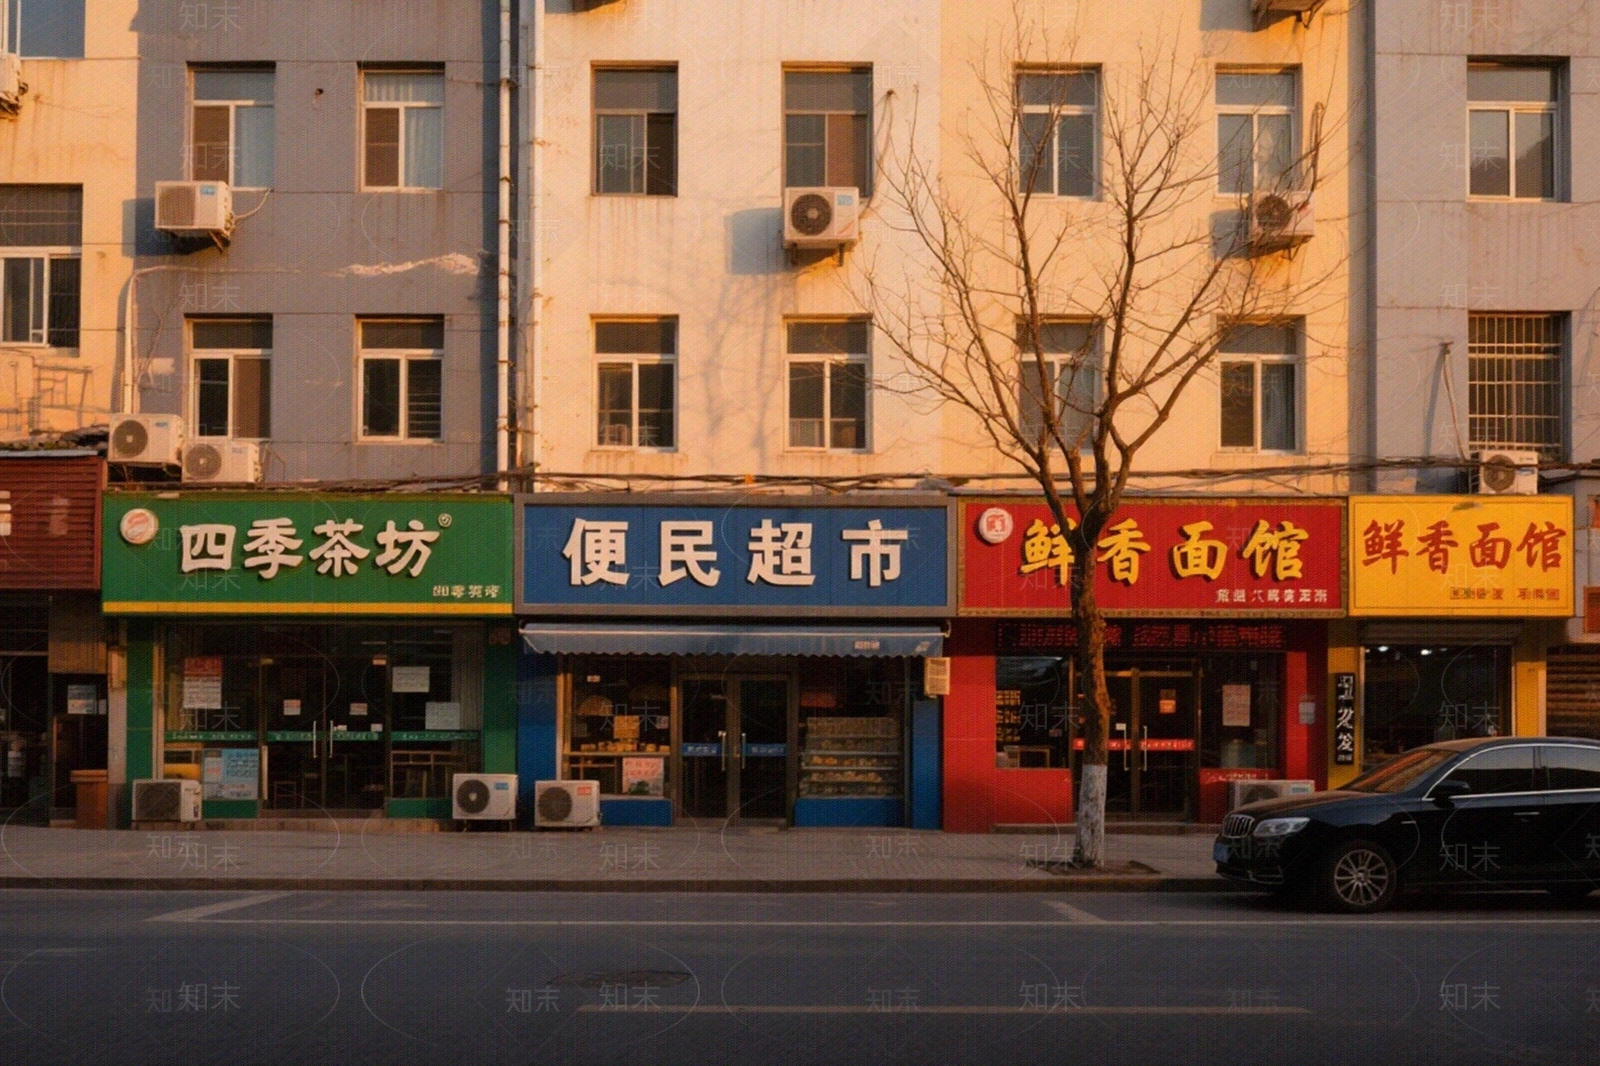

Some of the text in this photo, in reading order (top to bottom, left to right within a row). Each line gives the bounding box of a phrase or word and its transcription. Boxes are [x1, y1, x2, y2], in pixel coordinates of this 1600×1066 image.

[179, 517, 440, 580] 四季茶坊
[562, 517, 909, 588] 便民超市
[1020, 517, 1310, 586] 鲜香面馆
[1361, 519, 1567, 575] 鲜香面馆
